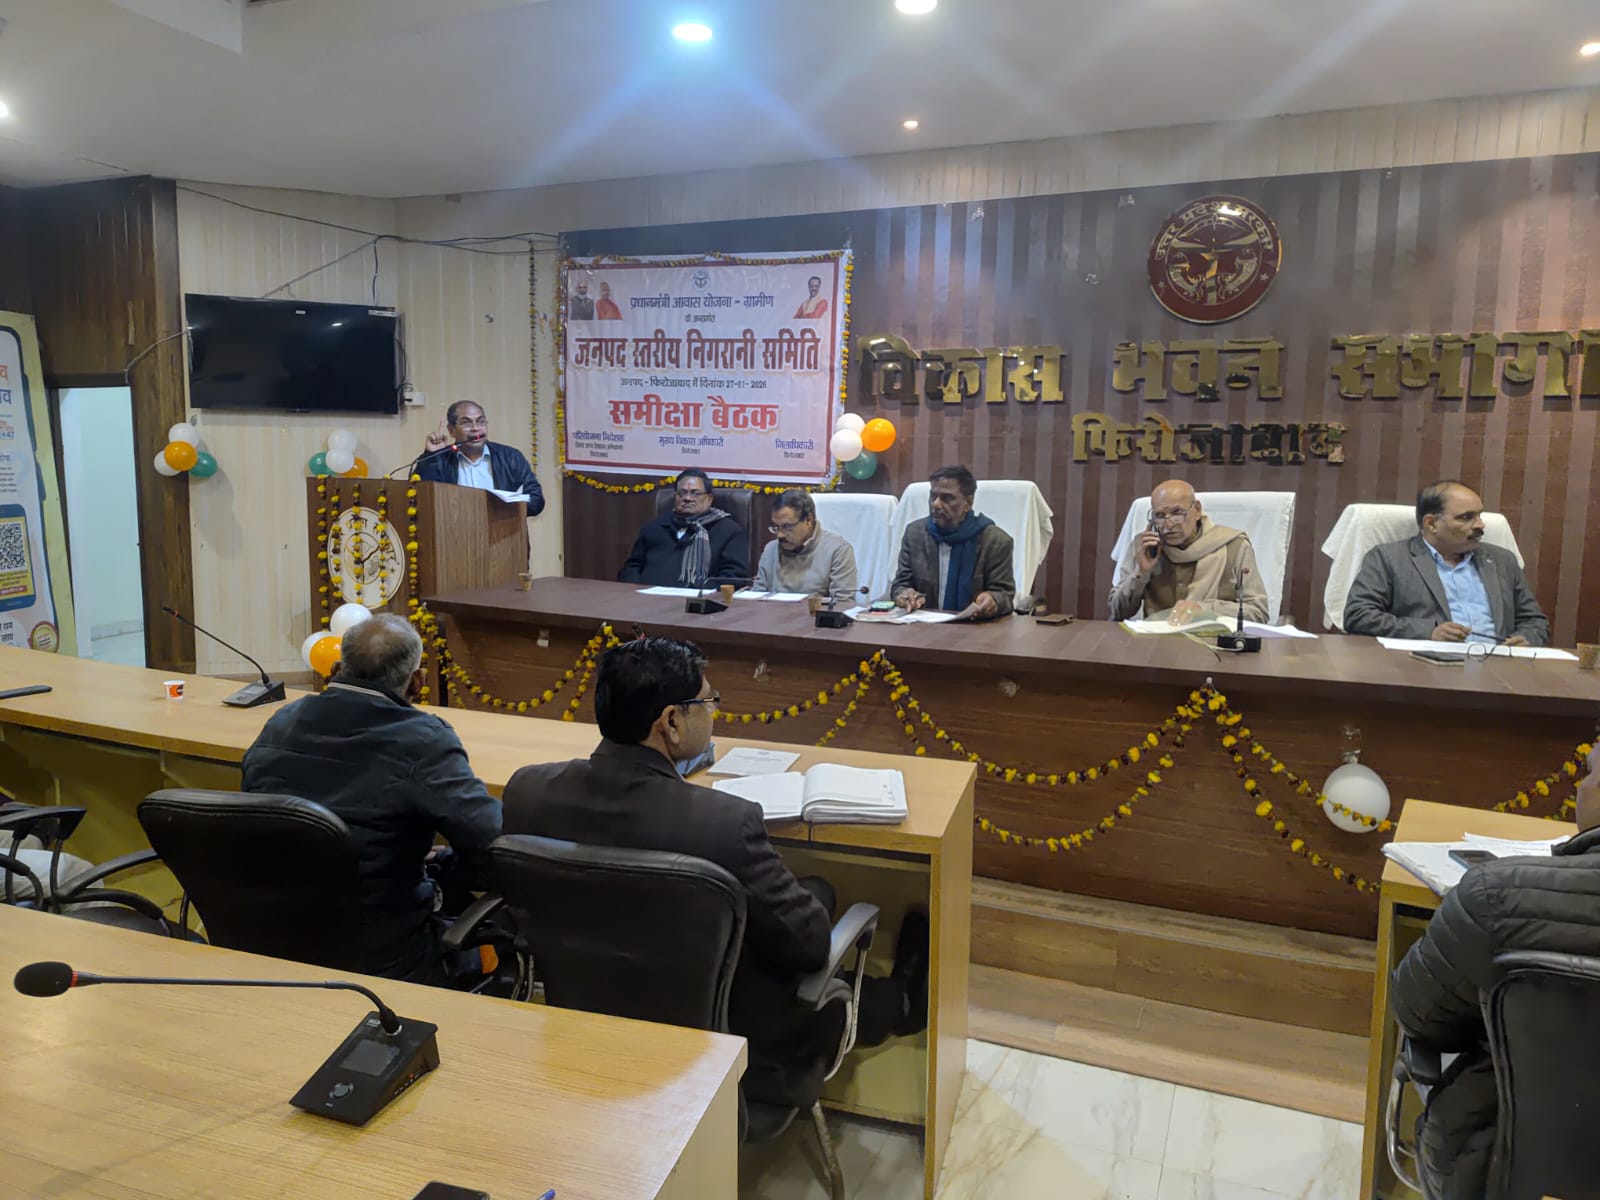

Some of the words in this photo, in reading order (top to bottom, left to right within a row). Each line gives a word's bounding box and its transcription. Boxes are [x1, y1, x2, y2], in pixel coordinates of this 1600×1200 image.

[630, 293, 670, 309] प्रधानमंत्री
[672, 296, 701, 309] आवास
[703, 293, 732, 308] योजना
[743, 292, 774, 308] ग्रामीण
[574, 338, 627, 368] जनपद
[633, 329, 681, 368] स्तरीय
[687, 328, 756, 369] निगरानी
[762, 328, 821, 370] समिति
[857, 335, 1063, 403] विकास
[1113, 337, 1284, 401] भवन
[1331, 329, 1600, 399] सभागा
[650, 376, 691, 388] फिरोजाबाद
[700, 377, 724, 388] दिनांक
[608, 393, 703, 428] समीक्षा
[707, 395, 779, 429] बैठक
[1072, 411, 1346, 463] फिरोजाबाद
